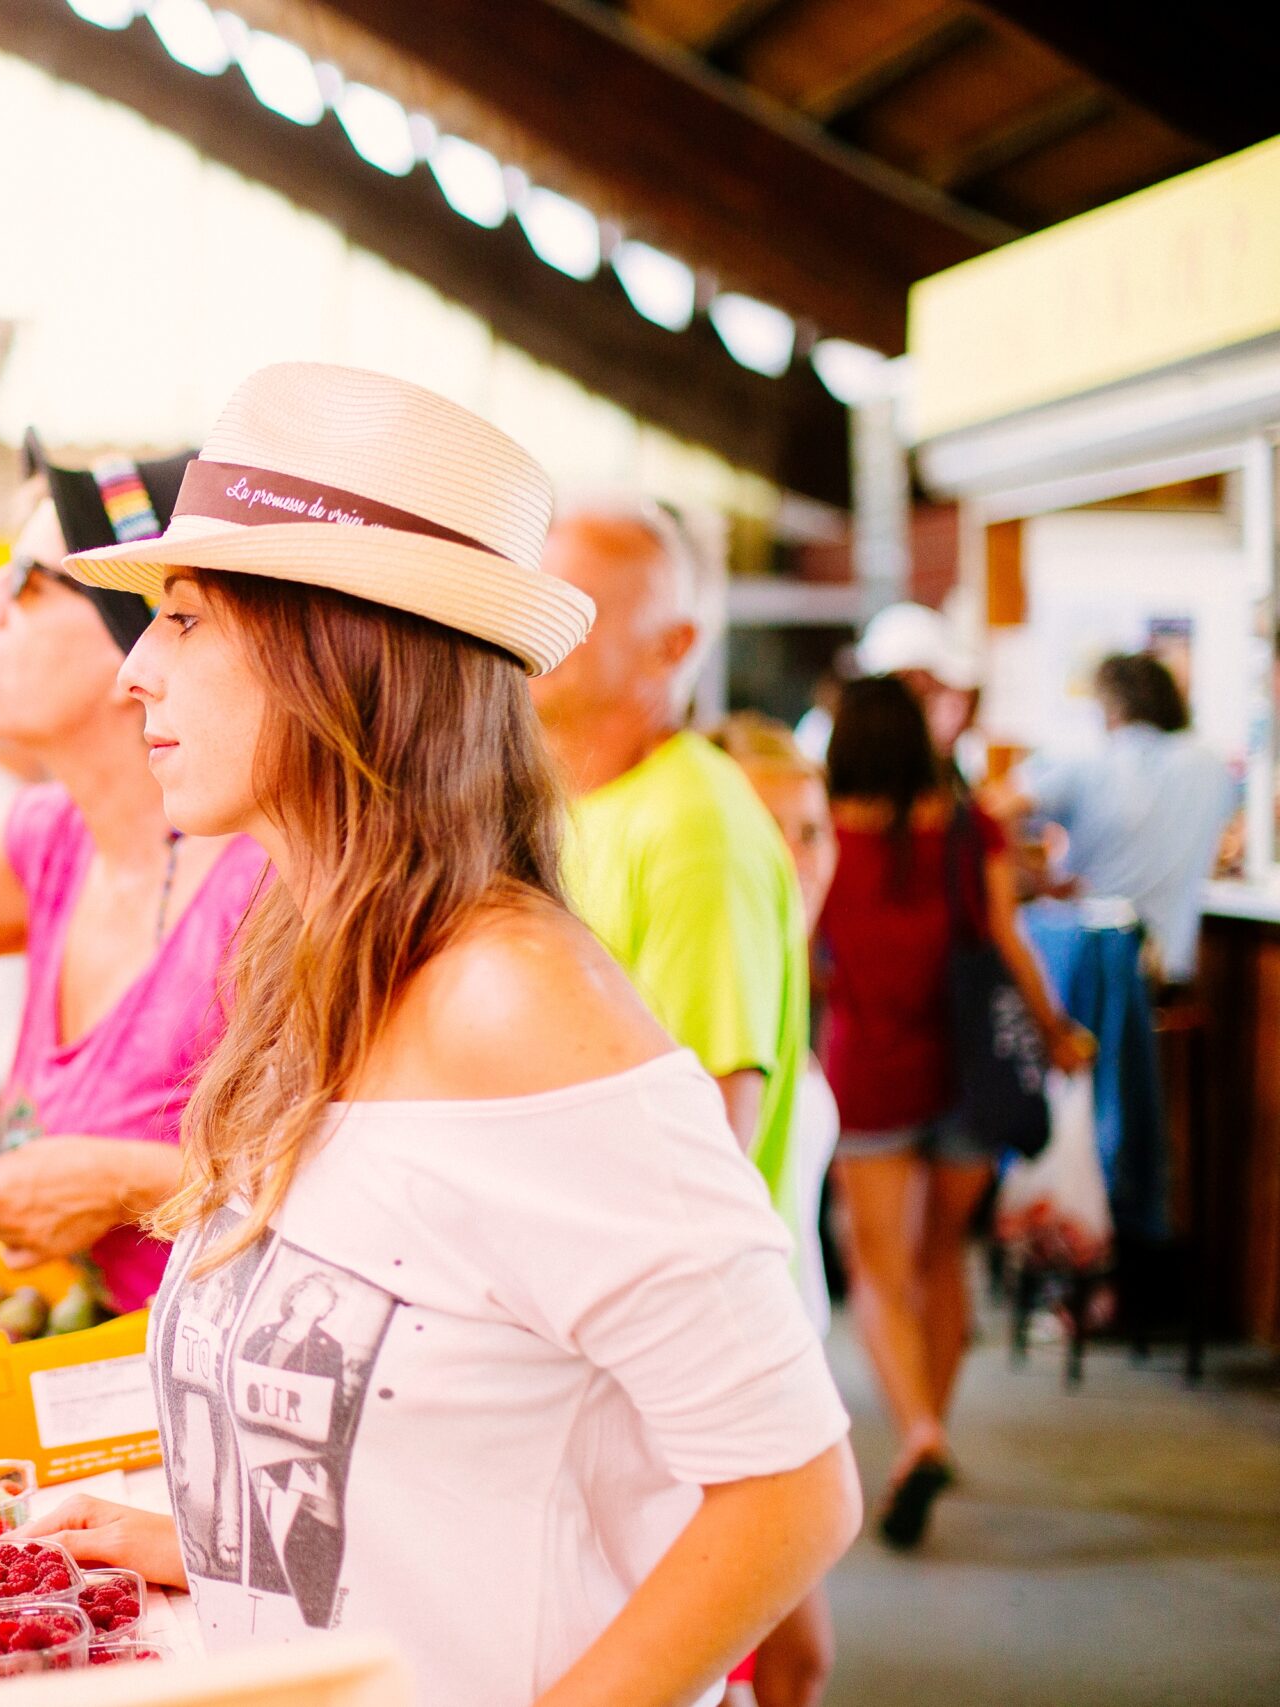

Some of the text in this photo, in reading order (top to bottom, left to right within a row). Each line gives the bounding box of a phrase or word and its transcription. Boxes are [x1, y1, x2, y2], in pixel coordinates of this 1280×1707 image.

[226, 477, 249, 500] La
[248, 488, 308, 514] promesse
[308, 497, 327, 518] de
[247, 1382, 302, 1423] OUR
